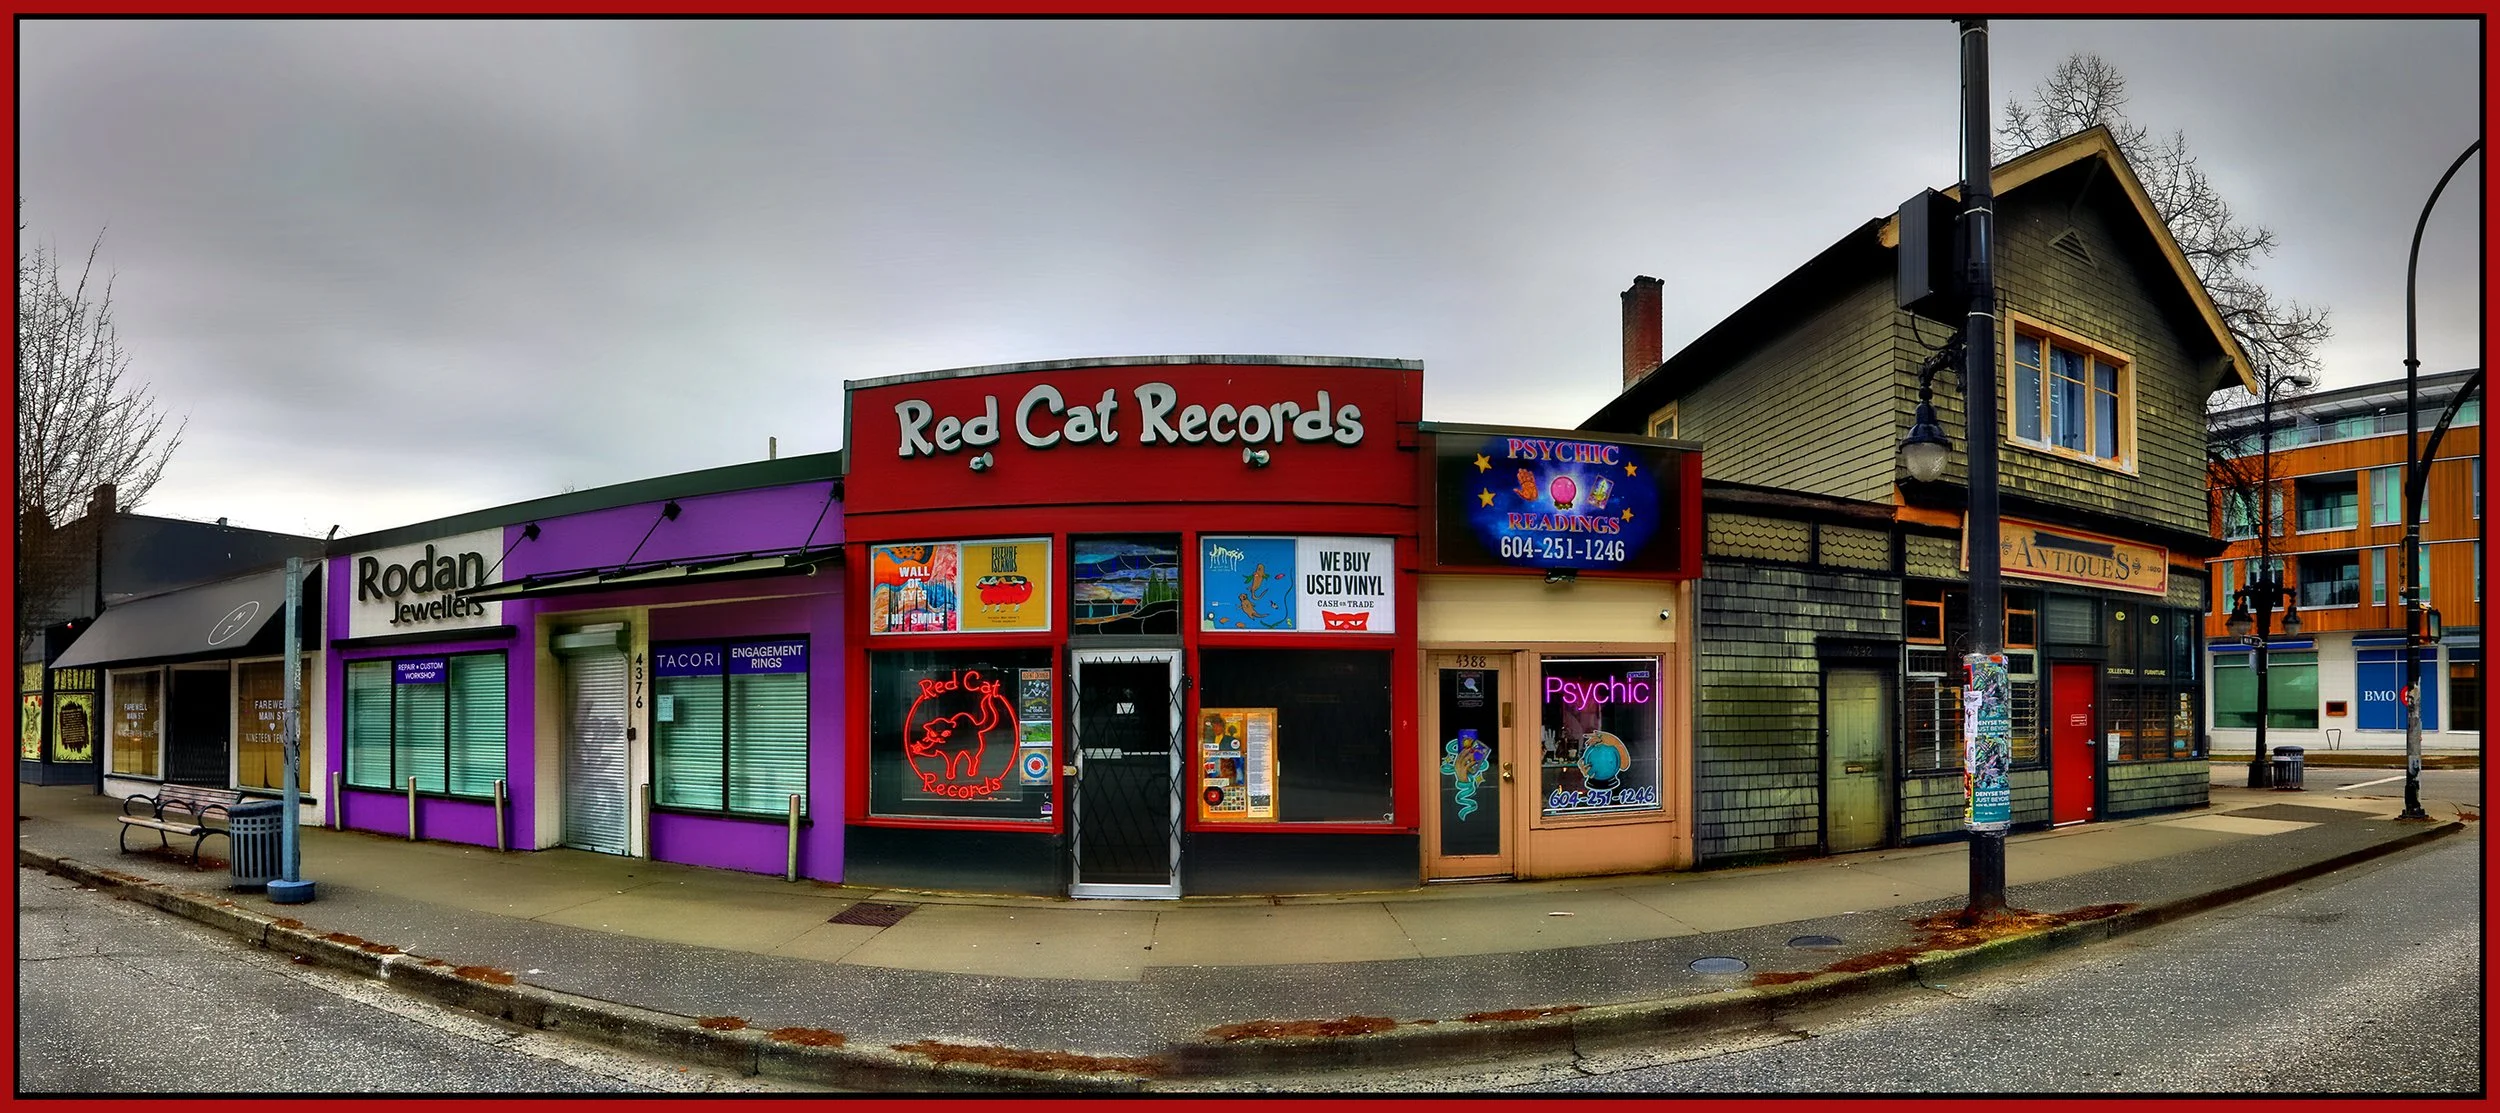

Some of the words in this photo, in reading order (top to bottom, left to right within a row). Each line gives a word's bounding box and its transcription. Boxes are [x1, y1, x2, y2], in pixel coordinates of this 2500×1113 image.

[895, 395, 1001, 458] Red
[1015, 384, 1119, 449] Cat
[1133, 382, 1365, 446] Records
[1507, 438, 1619, 466] PSYCHIC
[1507, 512, 1620, 535] READINGS
[1501, 535, 1625, 562] 604-251-1246
[1320, 551, 1341, 572] WE
[1343, 551, 1371, 572] BUY
[2012, 536, 2130, 581] ANTIQUES
[358, 544, 484, 601] Rodan
[899, 566, 931, 577] WALL
[907, 578, 922, 589] OF
[1307, 574, 1342, 595] USED
[1344, 575, 1385, 596] VINYL
[900, 589, 927, 601] EYES
[1317, 599, 1339, 607] CASH
[1347, 600, 1375, 608] TRADE
[390, 594, 485, 624] Jewellers
[884, 613, 905, 625] THE
[910, 612, 945, 624] SMILE
[657, 652, 721, 668] TACORI
[732, 645, 803, 658] ENGAGEMENT
[398, 663, 416, 671] REPAIR
[420, 662, 444, 670] CUSTOM
[751, 658, 782, 669] RINGS
[1456, 654, 1487, 668] 4388
[405, 672, 436, 680] WORKSHOP
[635, 652, 644, 709] 4376
[918, 669, 958, 700] Red
[963, 670, 1001, 698] Cat
[1545, 674, 1650, 711] Psychic
[2364, 690, 2396, 702] BMO
[124, 703, 148, 711] FAREWELL
[259, 711, 275, 720] MAIN
[922, 772, 1002, 799] Records
[1549, 786, 1655, 808] 604-251-1246
